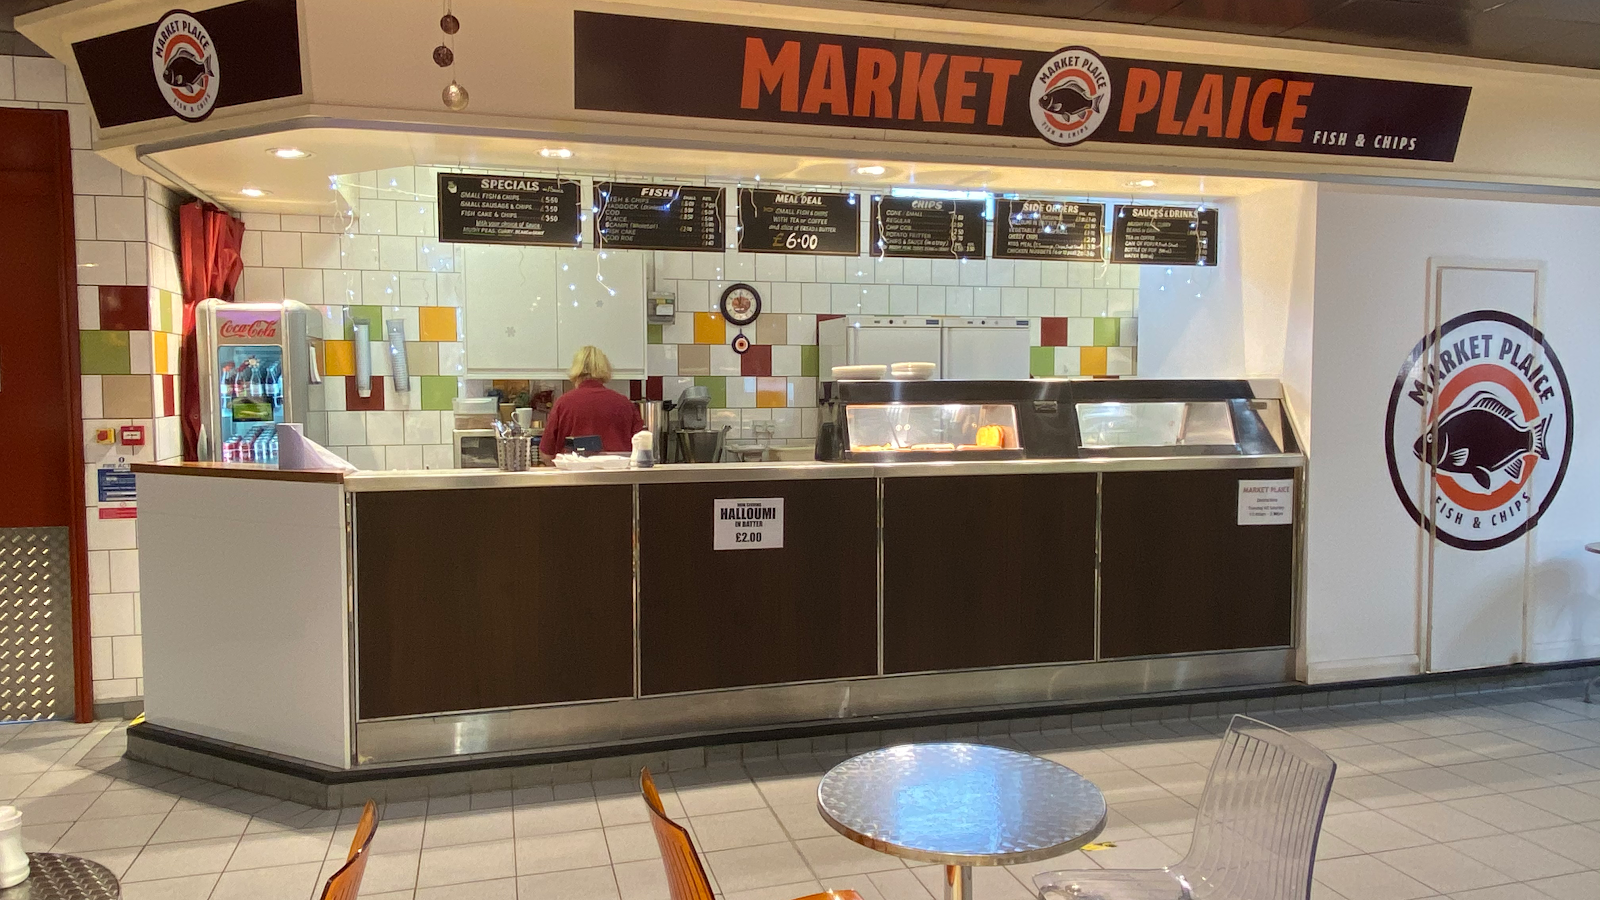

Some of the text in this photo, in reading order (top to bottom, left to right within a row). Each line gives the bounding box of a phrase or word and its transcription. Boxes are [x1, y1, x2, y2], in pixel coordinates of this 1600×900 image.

[155, 20, 210, 58] MARKET PLAICE
[1039, 56, 1107, 90] MARKET PLAICE
[740, 37, 1314, 143] MARKET PLAICE
[173, 97, 187, 111] FISH
[196, 93, 211, 111] CHIPS
[1041, 121, 1055, 136] FISH
[1067, 125, 1089, 139] CHIPS
[1313, 130, 1417, 151] FISH & CHIPS
[480, 178, 540, 191] SPECIALS
[460, 191, 480, 199] SMALL
[640, 187, 674, 198] FISH
[460, 200, 480, 208] SMALL
[774, 194, 823, 205] MEAL DEAL
[911, 200, 943, 210] CHIPS
[1022, 202, 1045, 213] SIDE
[1131, 208, 1164, 218] SAUCES
[1169, 209, 1198, 219] DRINKS
[1408, 334, 1555, 407] MARKET PLAICE
[720, 507, 776, 520] HALLOUMI
[1435, 492, 1531, 528] FISH & CHIPS
[735, 532, 762, 543] £2.00
